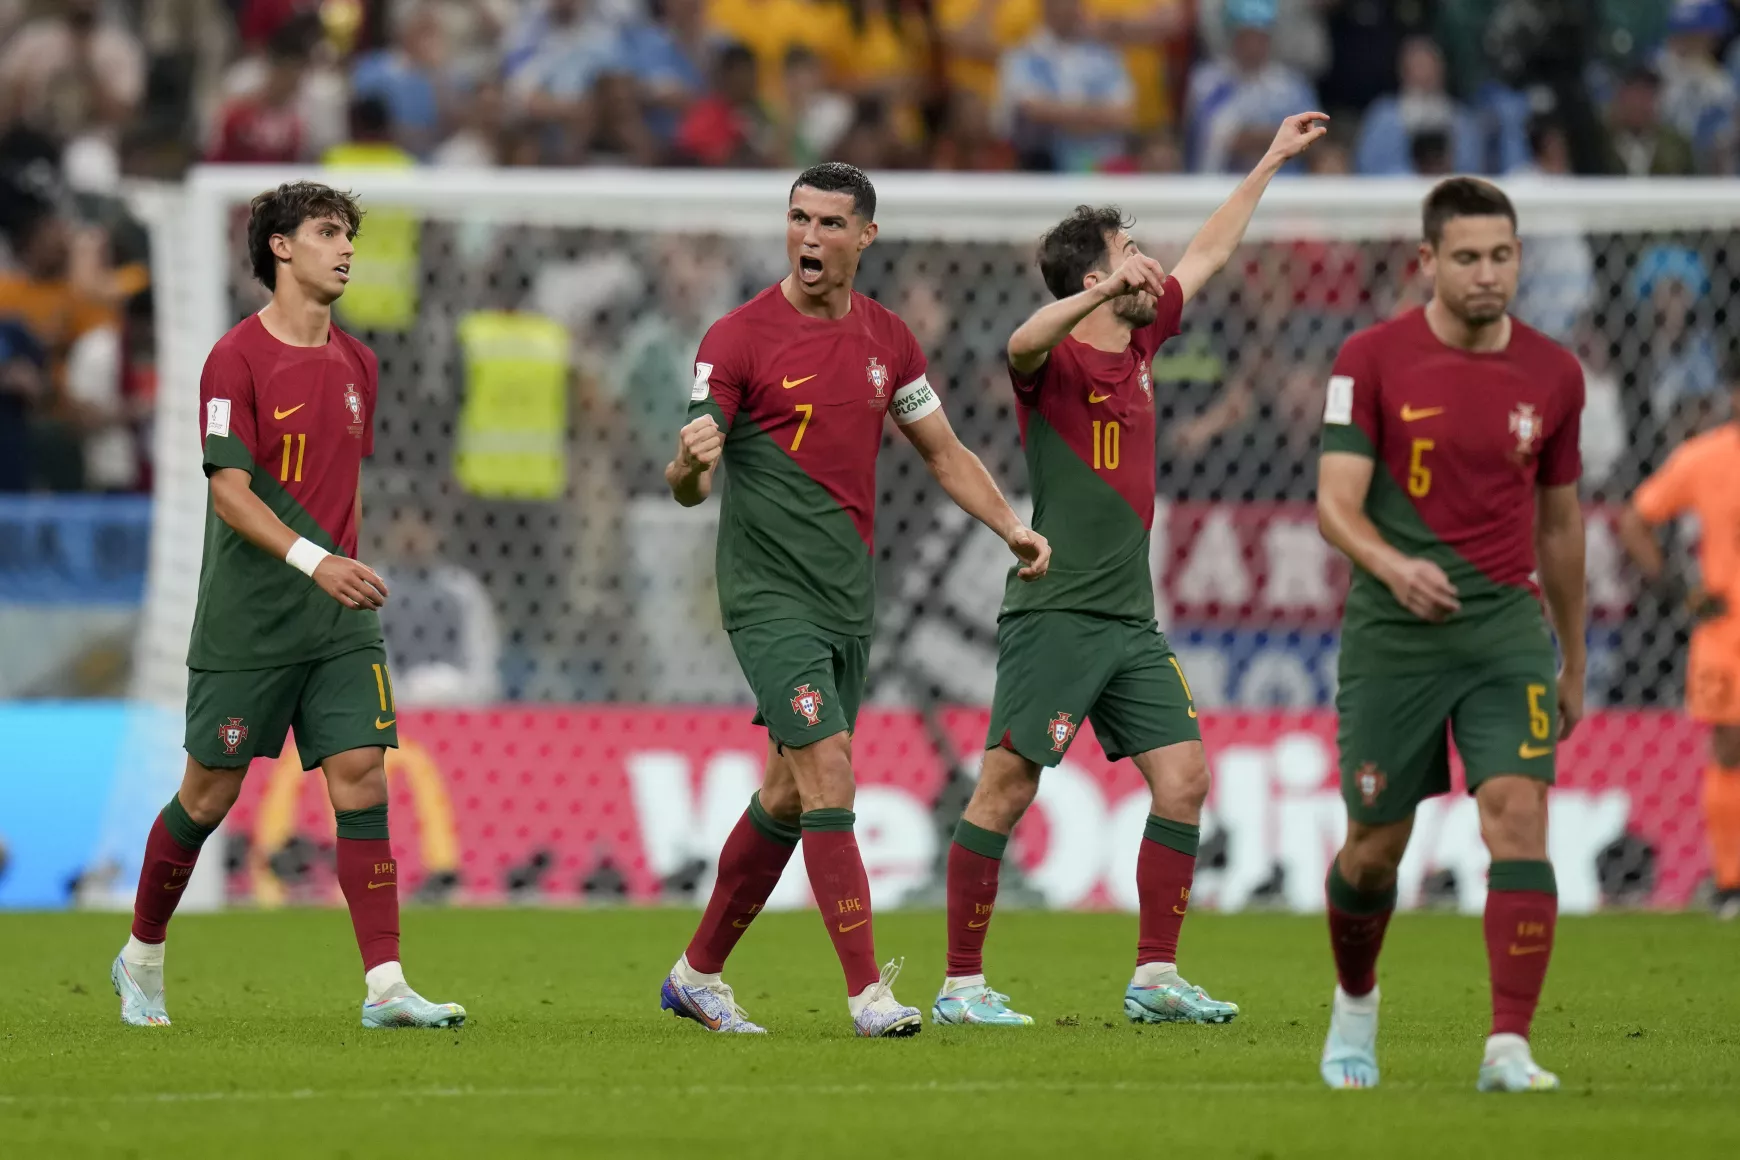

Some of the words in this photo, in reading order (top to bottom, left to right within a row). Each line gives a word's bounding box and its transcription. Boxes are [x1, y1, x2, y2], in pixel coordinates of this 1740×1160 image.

[892, 393, 915, 408] SAVE
[916, 384, 929, 396] THE
[790, 404, 813, 452] 7
[1092, 421, 1119, 470] 10
[280, 434, 305, 482] 11
[1408, 438, 1435, 498] 5
[1527, 684, 1549, 739] 5
